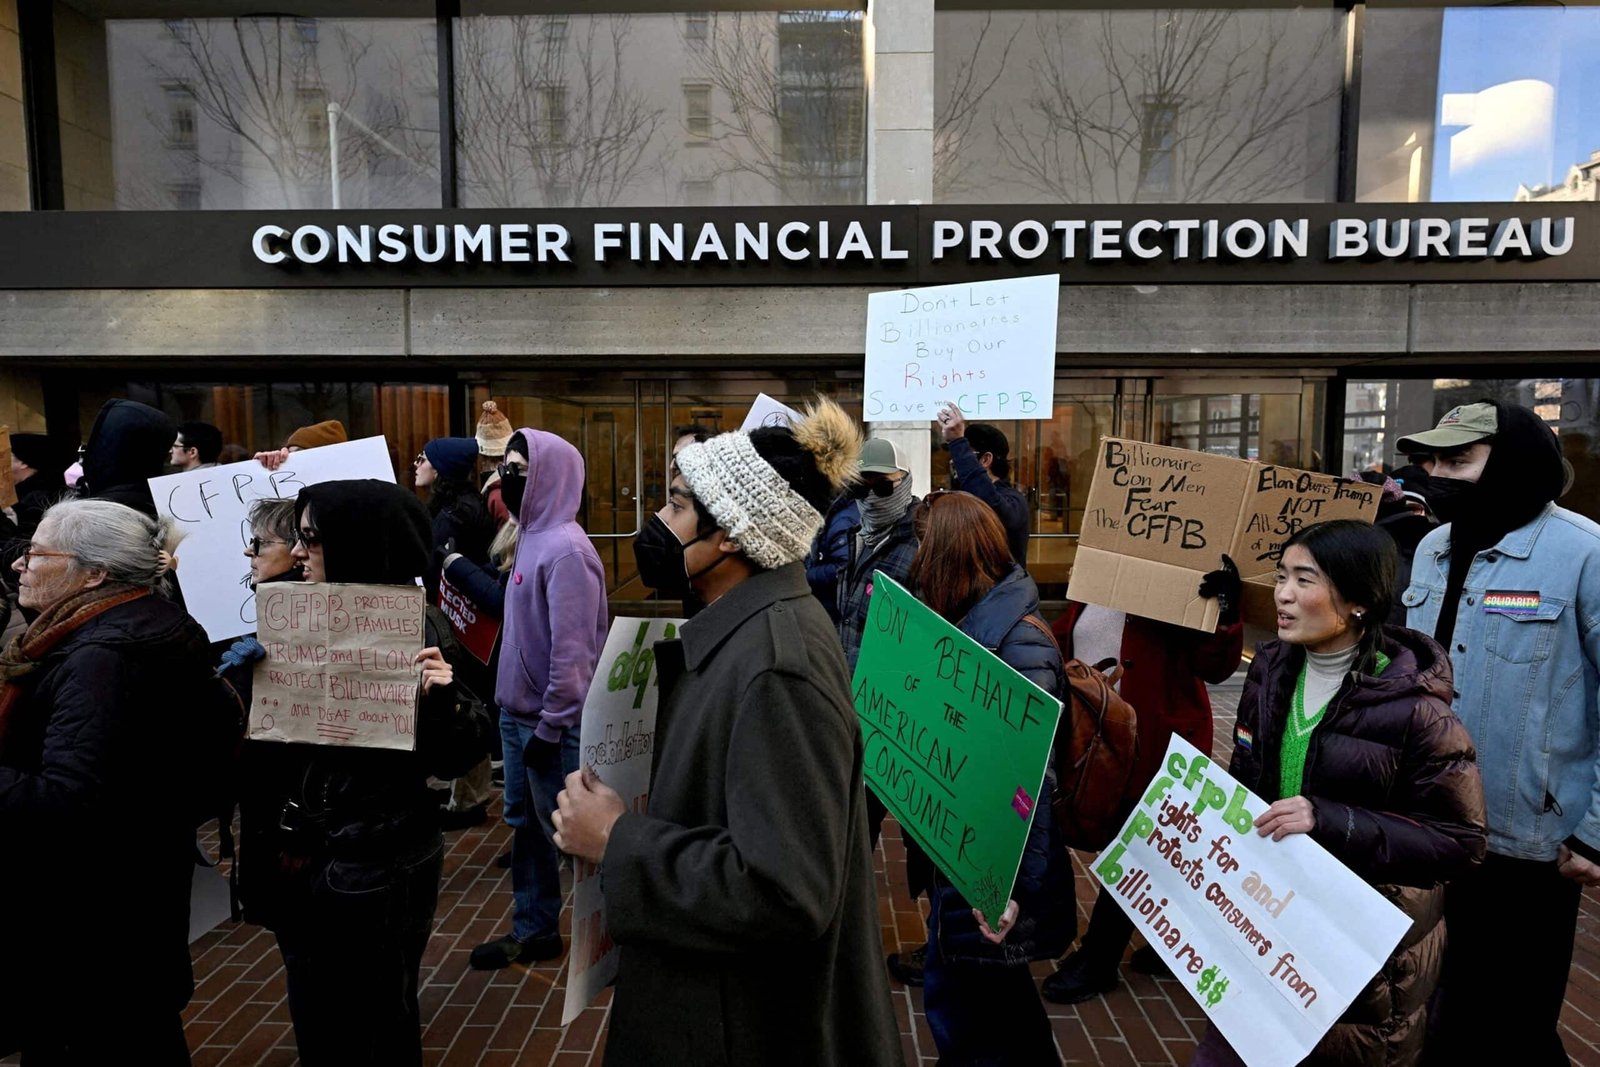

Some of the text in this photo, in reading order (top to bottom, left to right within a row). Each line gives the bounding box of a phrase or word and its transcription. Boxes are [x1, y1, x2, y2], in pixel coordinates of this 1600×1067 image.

[252, 217, 1575, 264] CONSUMER FINANCIAL PROTECTION BUREAU
[969, 287, 1009, 307] Let
[880, 313, 1020, 344] Billionaires
[915, 339, 1007, 361] Buy Our
[904, 362, 987, 389] Rights
[867, 390, 926, 416] Save
[957, 391, 1038, 414] CFPB
[1105, 441, 1202, 473] Billionaire
[1112, 465, 1206, 496] Con Men
[1257, 466, 1294, 492] Elon
[168, 470, 307, 523] CFPB
[1124, 487, 1177, 515] Fear
[1280, 497, 1326, 517] NOT
[1089, 507, 1207, 549] The CFPB
[1245, 512, 1270, 533] All
[1250, 538, 1263, 551] of
[264, 592, 350, 633] CFPB
[354, 594, 421, 614] PROTECTS
[439, 579, 477, 625] ELECTED
[440, 599, 467, 634] MUSK
[1485, 596, 1538, 608] SOLIDARITY
[355, 616, 420, 636] FAMILIES
[265, 642, 414, 675] TRUMP and ELON
[876, 593, 1045, 732] ON BEHALF
[268, 670, 416, 710] PROTECT BILLIONAIRES
[904, 674, 968, 733] OF THE
[291, 703, 310, 718] and
[318, 706, 351, 722] DGAF
[358, 711, 389, 724] about
[853, 677, 968, 784] AMERICAN
[863, 730, 983, 873] CONSUMER
[1167, 752, 1253, 835] cfpb
[1144, 776, 1296, 919] fights for and
[1121, 808, 1205, 890] protects
[1269, 952, 1317, 1009] from
